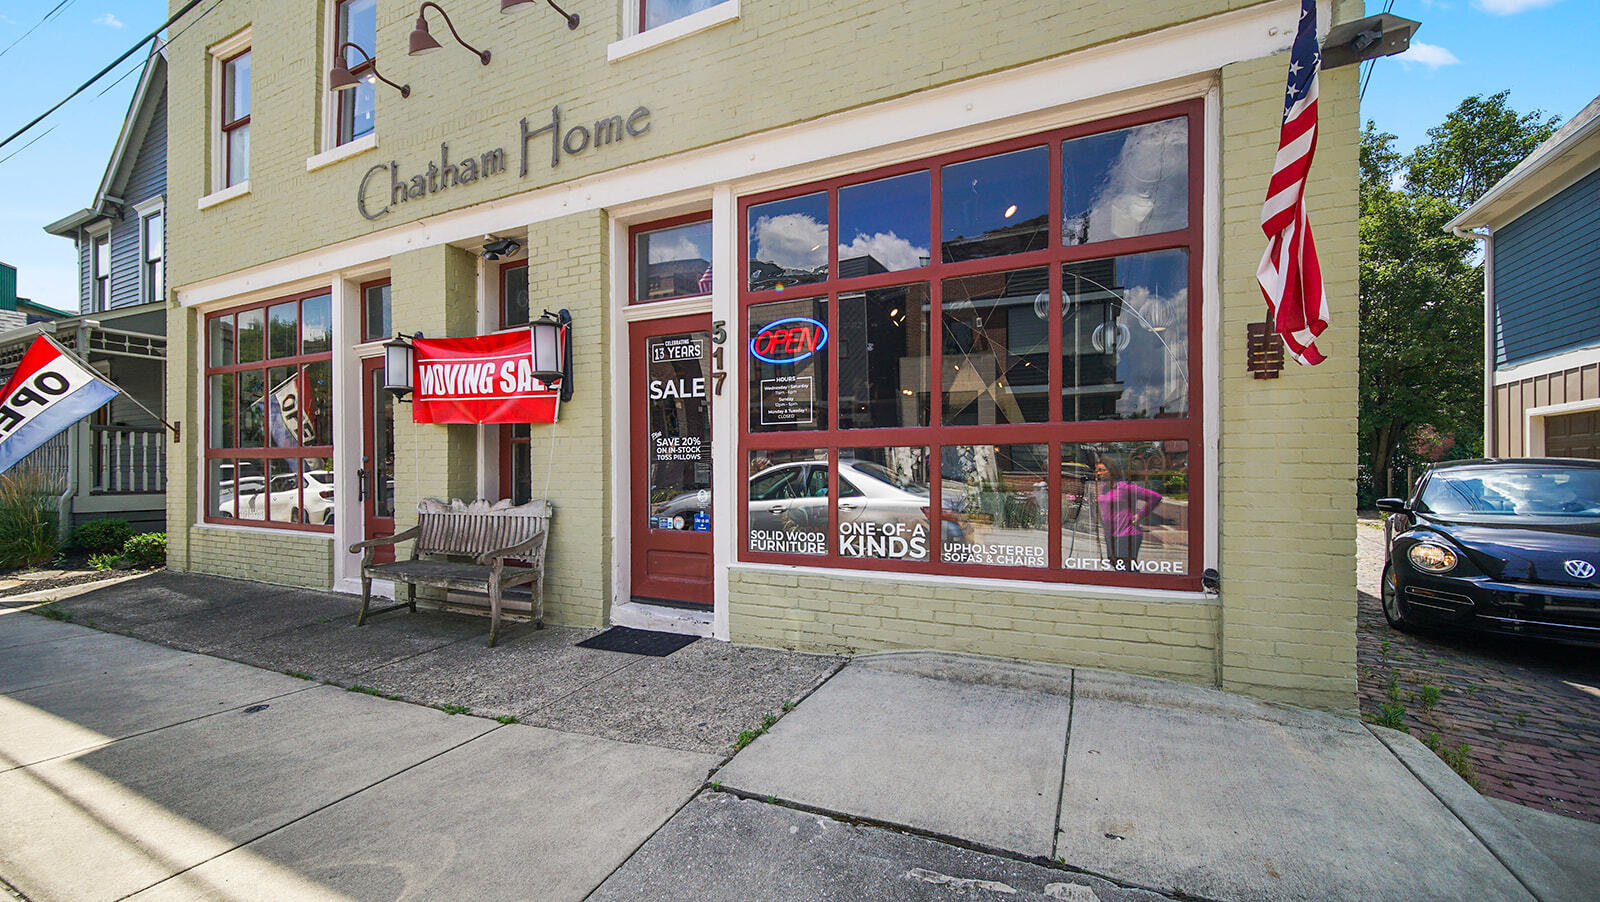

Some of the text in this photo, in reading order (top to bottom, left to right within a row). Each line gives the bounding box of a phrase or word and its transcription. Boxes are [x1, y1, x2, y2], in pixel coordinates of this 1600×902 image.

[357, 105, 650, 220] Chatham Home
[755, 326, 821, 355] OPEN
[654, 344, 701, 360] 13 YEARS
[418, 362, 496, 396] MOVING
[650, 377, 706, 400] SALE
[656, 436, 701, 447] SAVE 20%
[750, 529, 826, 543] SOLID WOOD
[839, 522, 926, 537] ONE-OF-A
[750, 539, 826, 554] FURNITURE
[839, 534, 927, 559] KINDS
[943, 543, 1045, 557] UPHOLSTERED
[944, 552, 1045, 566] SOFAS & CHAIRS
[1065, 557, 1184, 573] GIFTS & MORE
